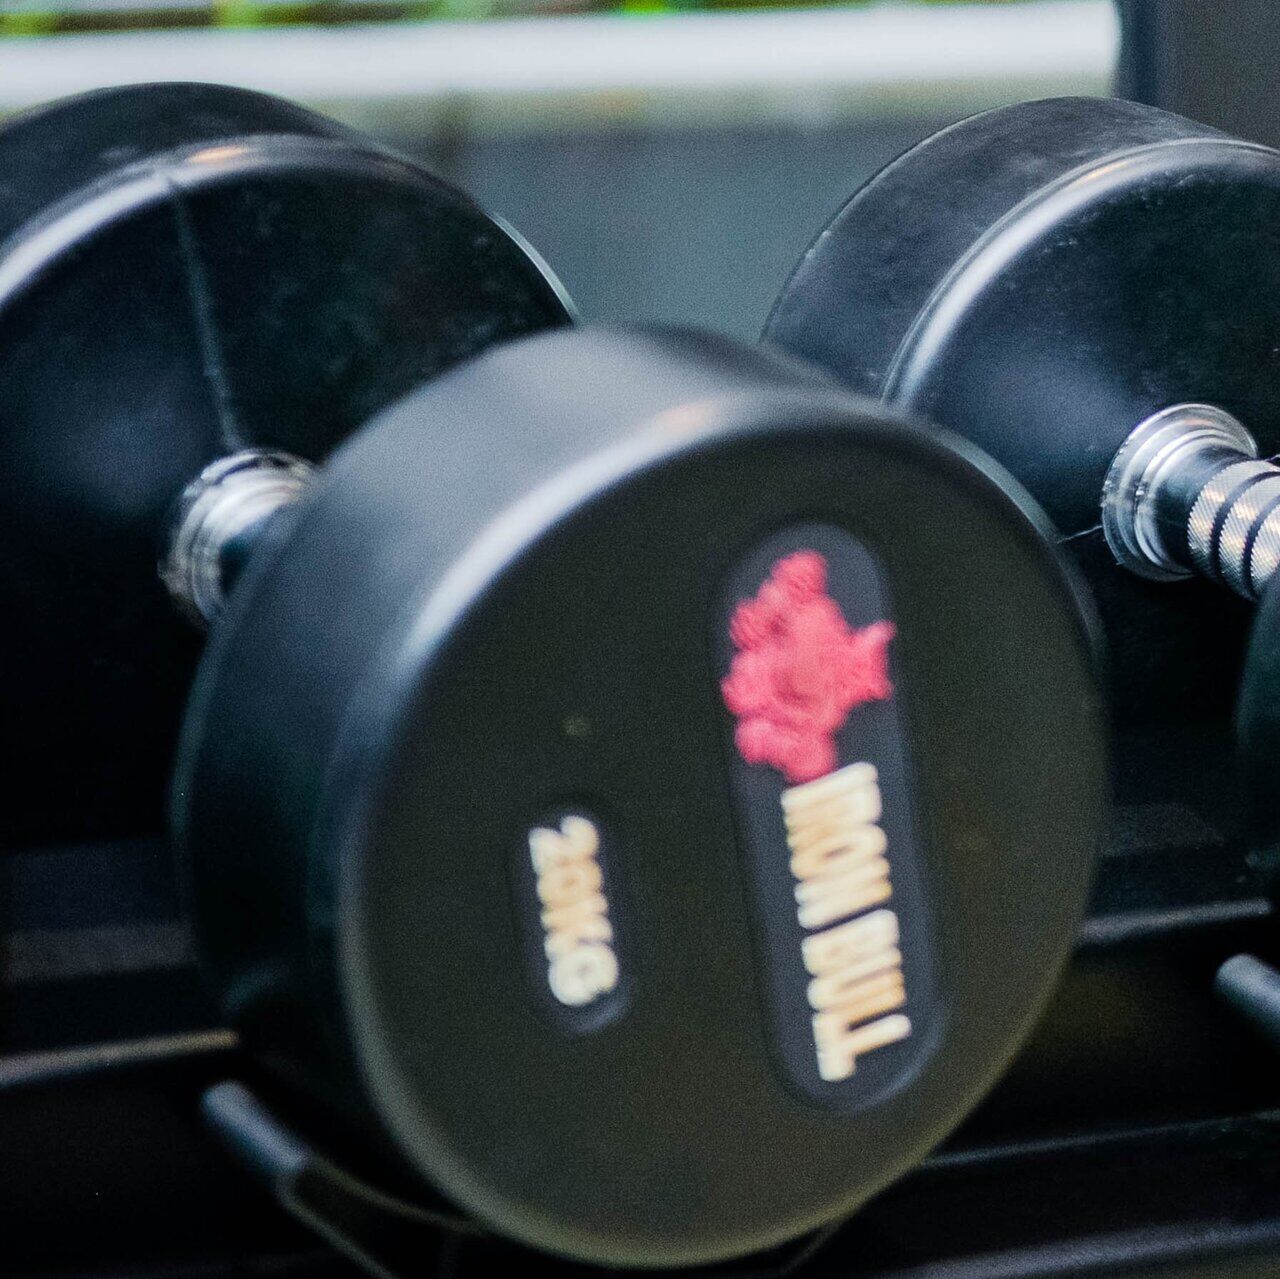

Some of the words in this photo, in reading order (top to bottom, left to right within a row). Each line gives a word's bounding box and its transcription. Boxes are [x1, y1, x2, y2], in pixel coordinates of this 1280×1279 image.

[528, 815, 619, 1007] 20KG
[781, 761, 893, 929] IRON
[801, 908, 912, 1082] BULL
